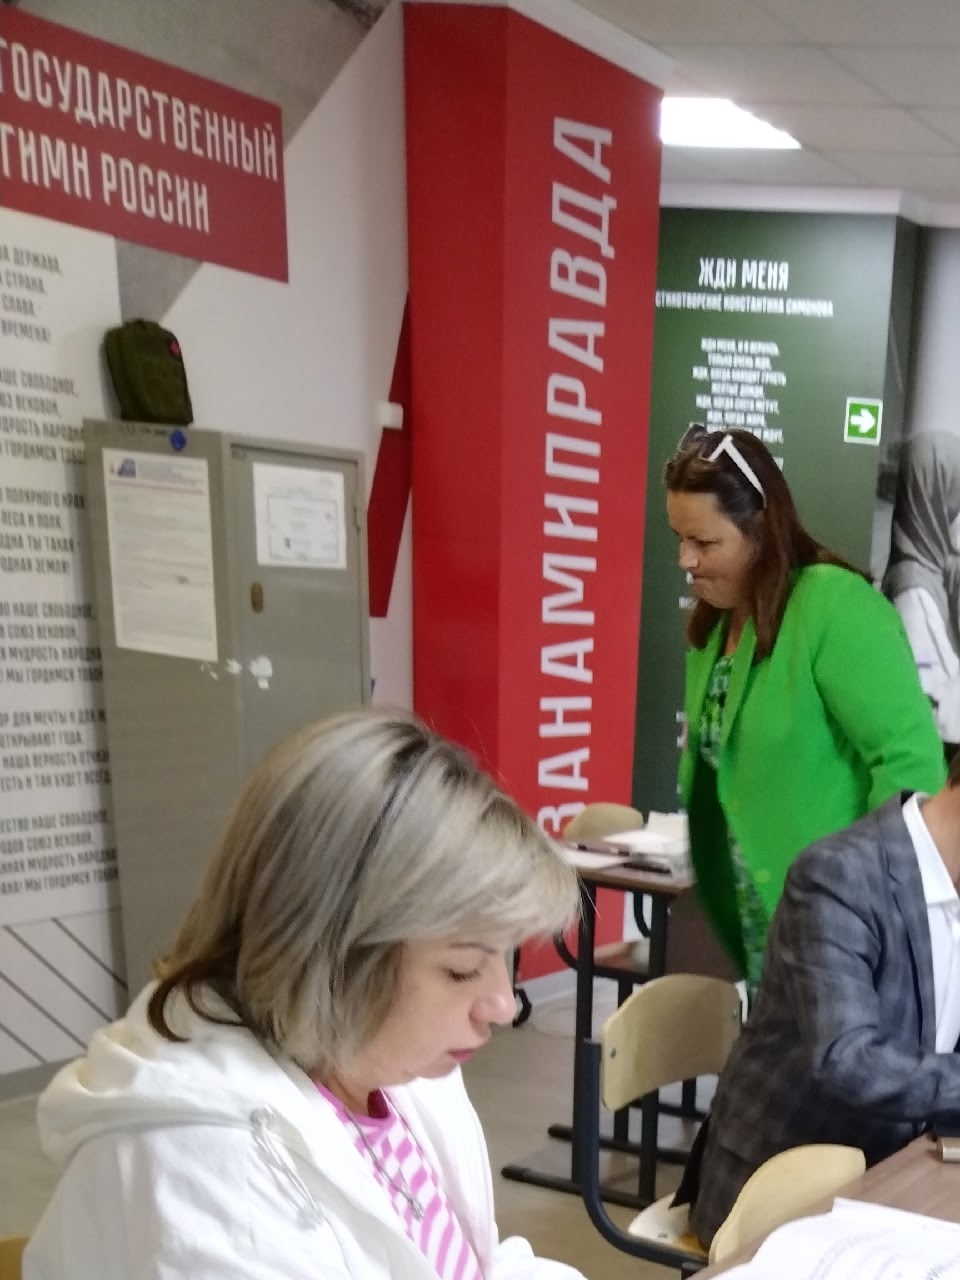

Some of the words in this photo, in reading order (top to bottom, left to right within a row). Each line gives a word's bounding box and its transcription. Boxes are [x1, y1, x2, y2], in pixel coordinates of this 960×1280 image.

[0, 121, 91, 200] ГИМН
[101, 151, 210, 234] РОССИИ
[699, 257, 737, 291] ЖДИ
[741, 258, 789, 291] МЕНЯ
